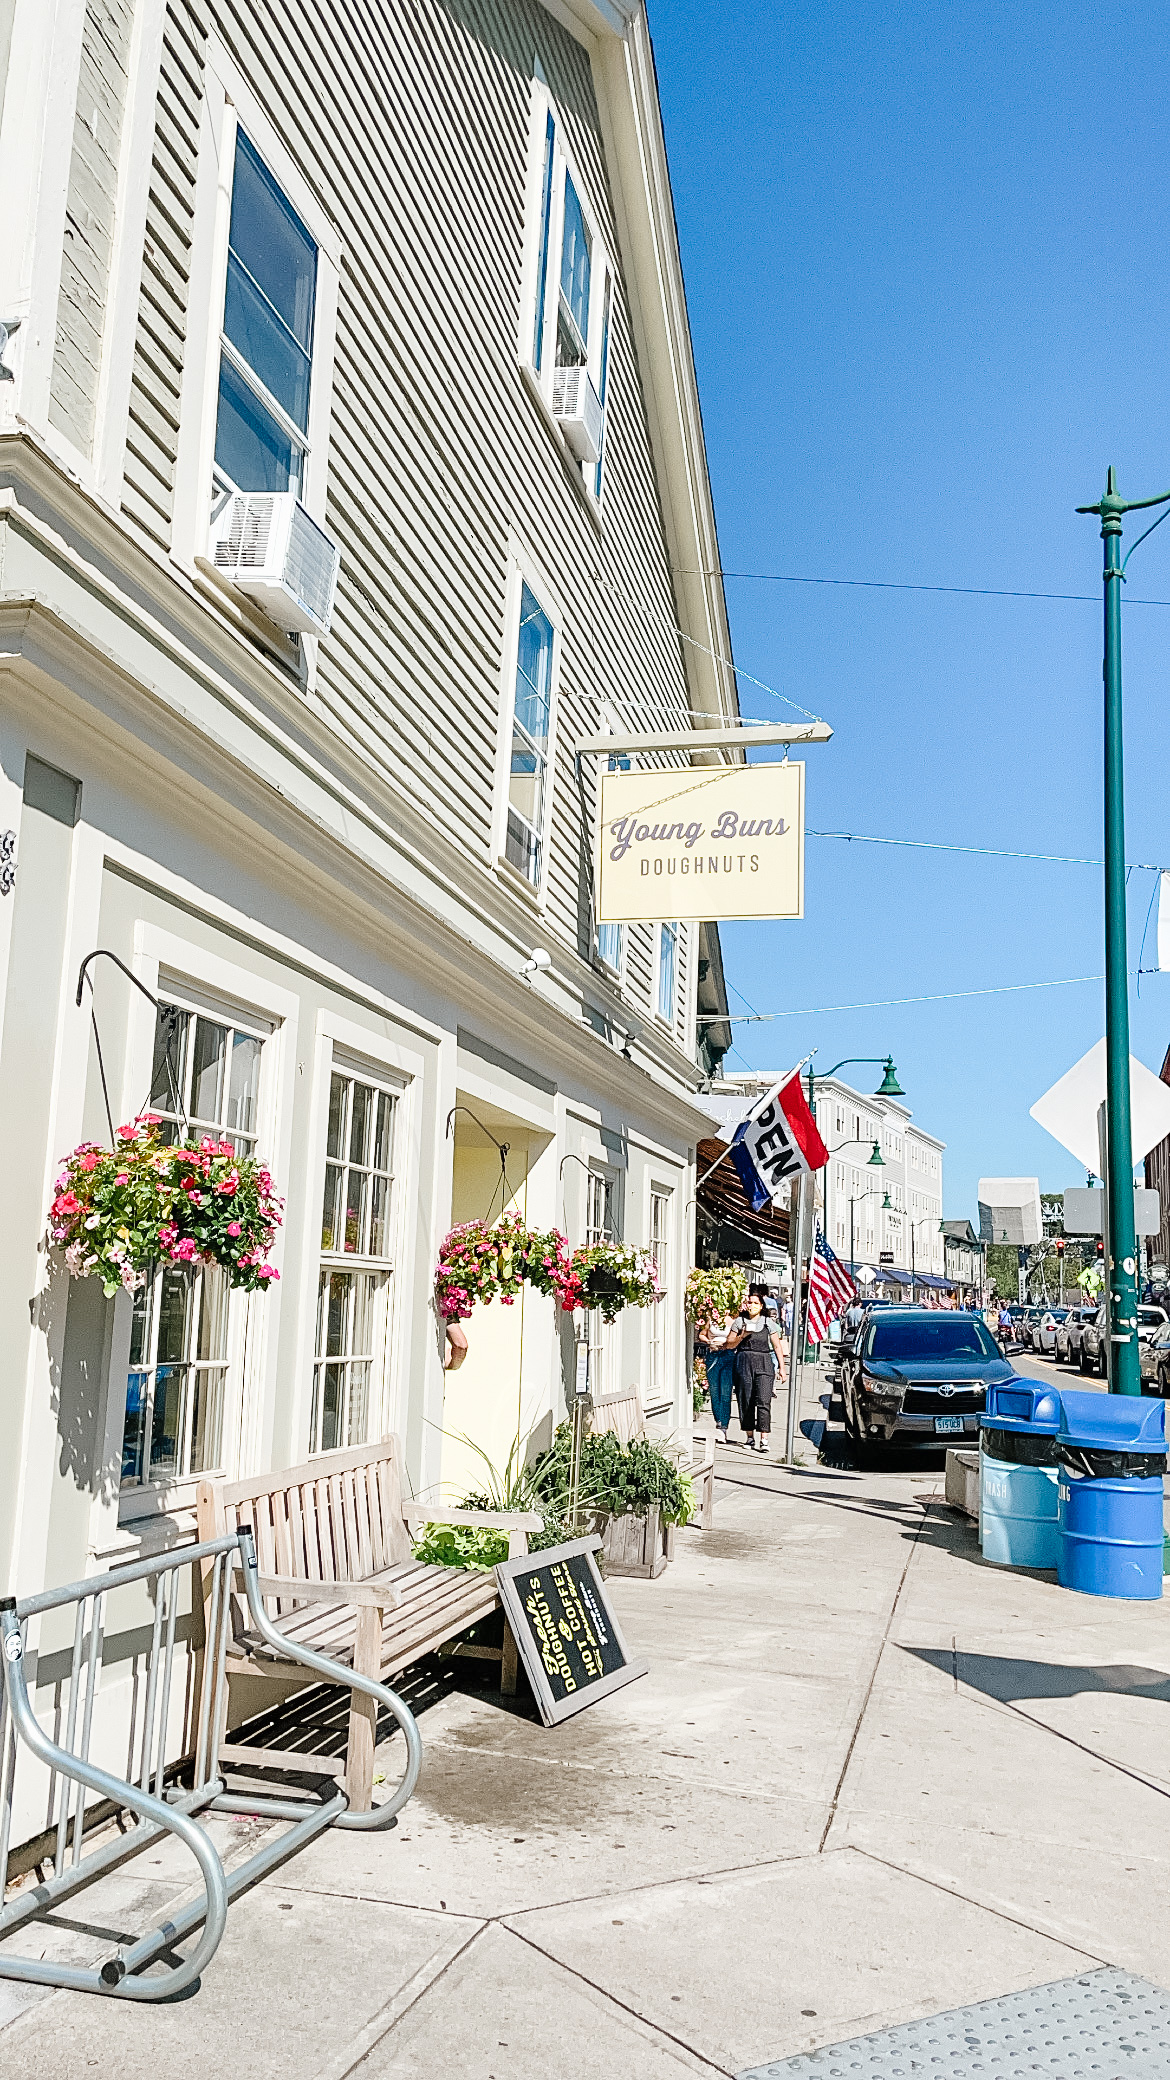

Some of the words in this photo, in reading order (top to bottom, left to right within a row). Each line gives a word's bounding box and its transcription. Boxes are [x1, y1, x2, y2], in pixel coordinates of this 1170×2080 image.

[609, 817, 706, 862] Young
[710, 810, 791, 839] Buns
[640, 854, 760, 876] DOUGHNUTS
[754, 1102, 803, 1186] PEN
[985, 1480, 1007, 1499] TRASH
[550, 1564, 581, 1633] COFFEE
[526, 1595, 560, 1676] Fresh
[529, 1576, 577, 1693] DOUGHNUTS
[576, 1639, 598, 1677] HOT
